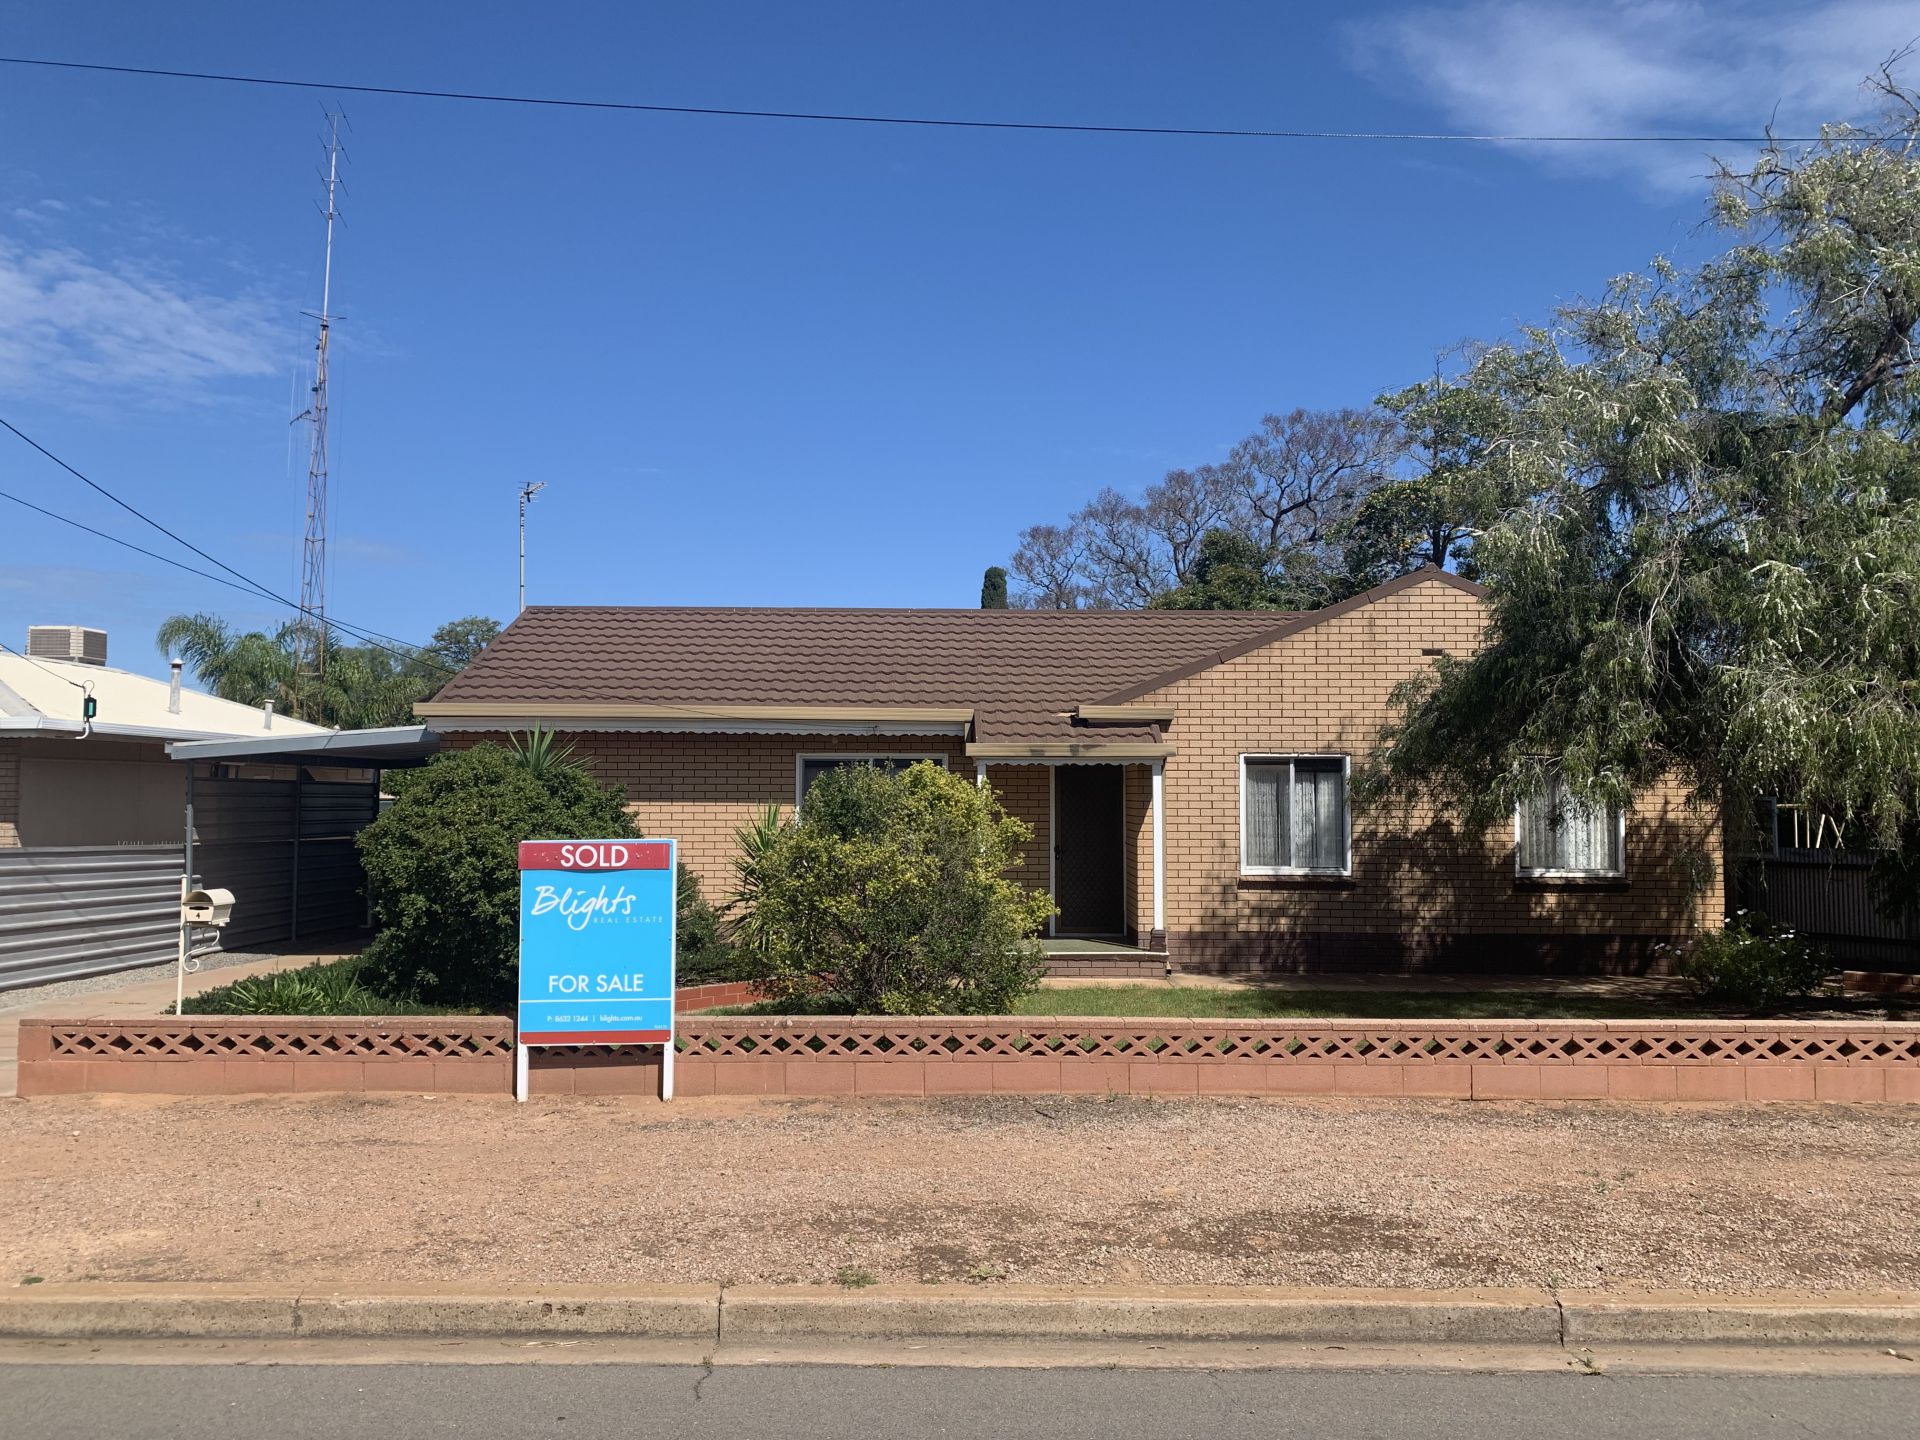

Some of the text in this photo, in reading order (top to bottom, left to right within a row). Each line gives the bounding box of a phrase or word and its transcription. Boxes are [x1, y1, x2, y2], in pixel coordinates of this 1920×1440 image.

[560, 845, 628, 867] SOLD
[531, 885, 637, 931] Blights
[593, 916, 663, 924] REAL ESTATE
[548, 973, 644, 993] FOR SALE
